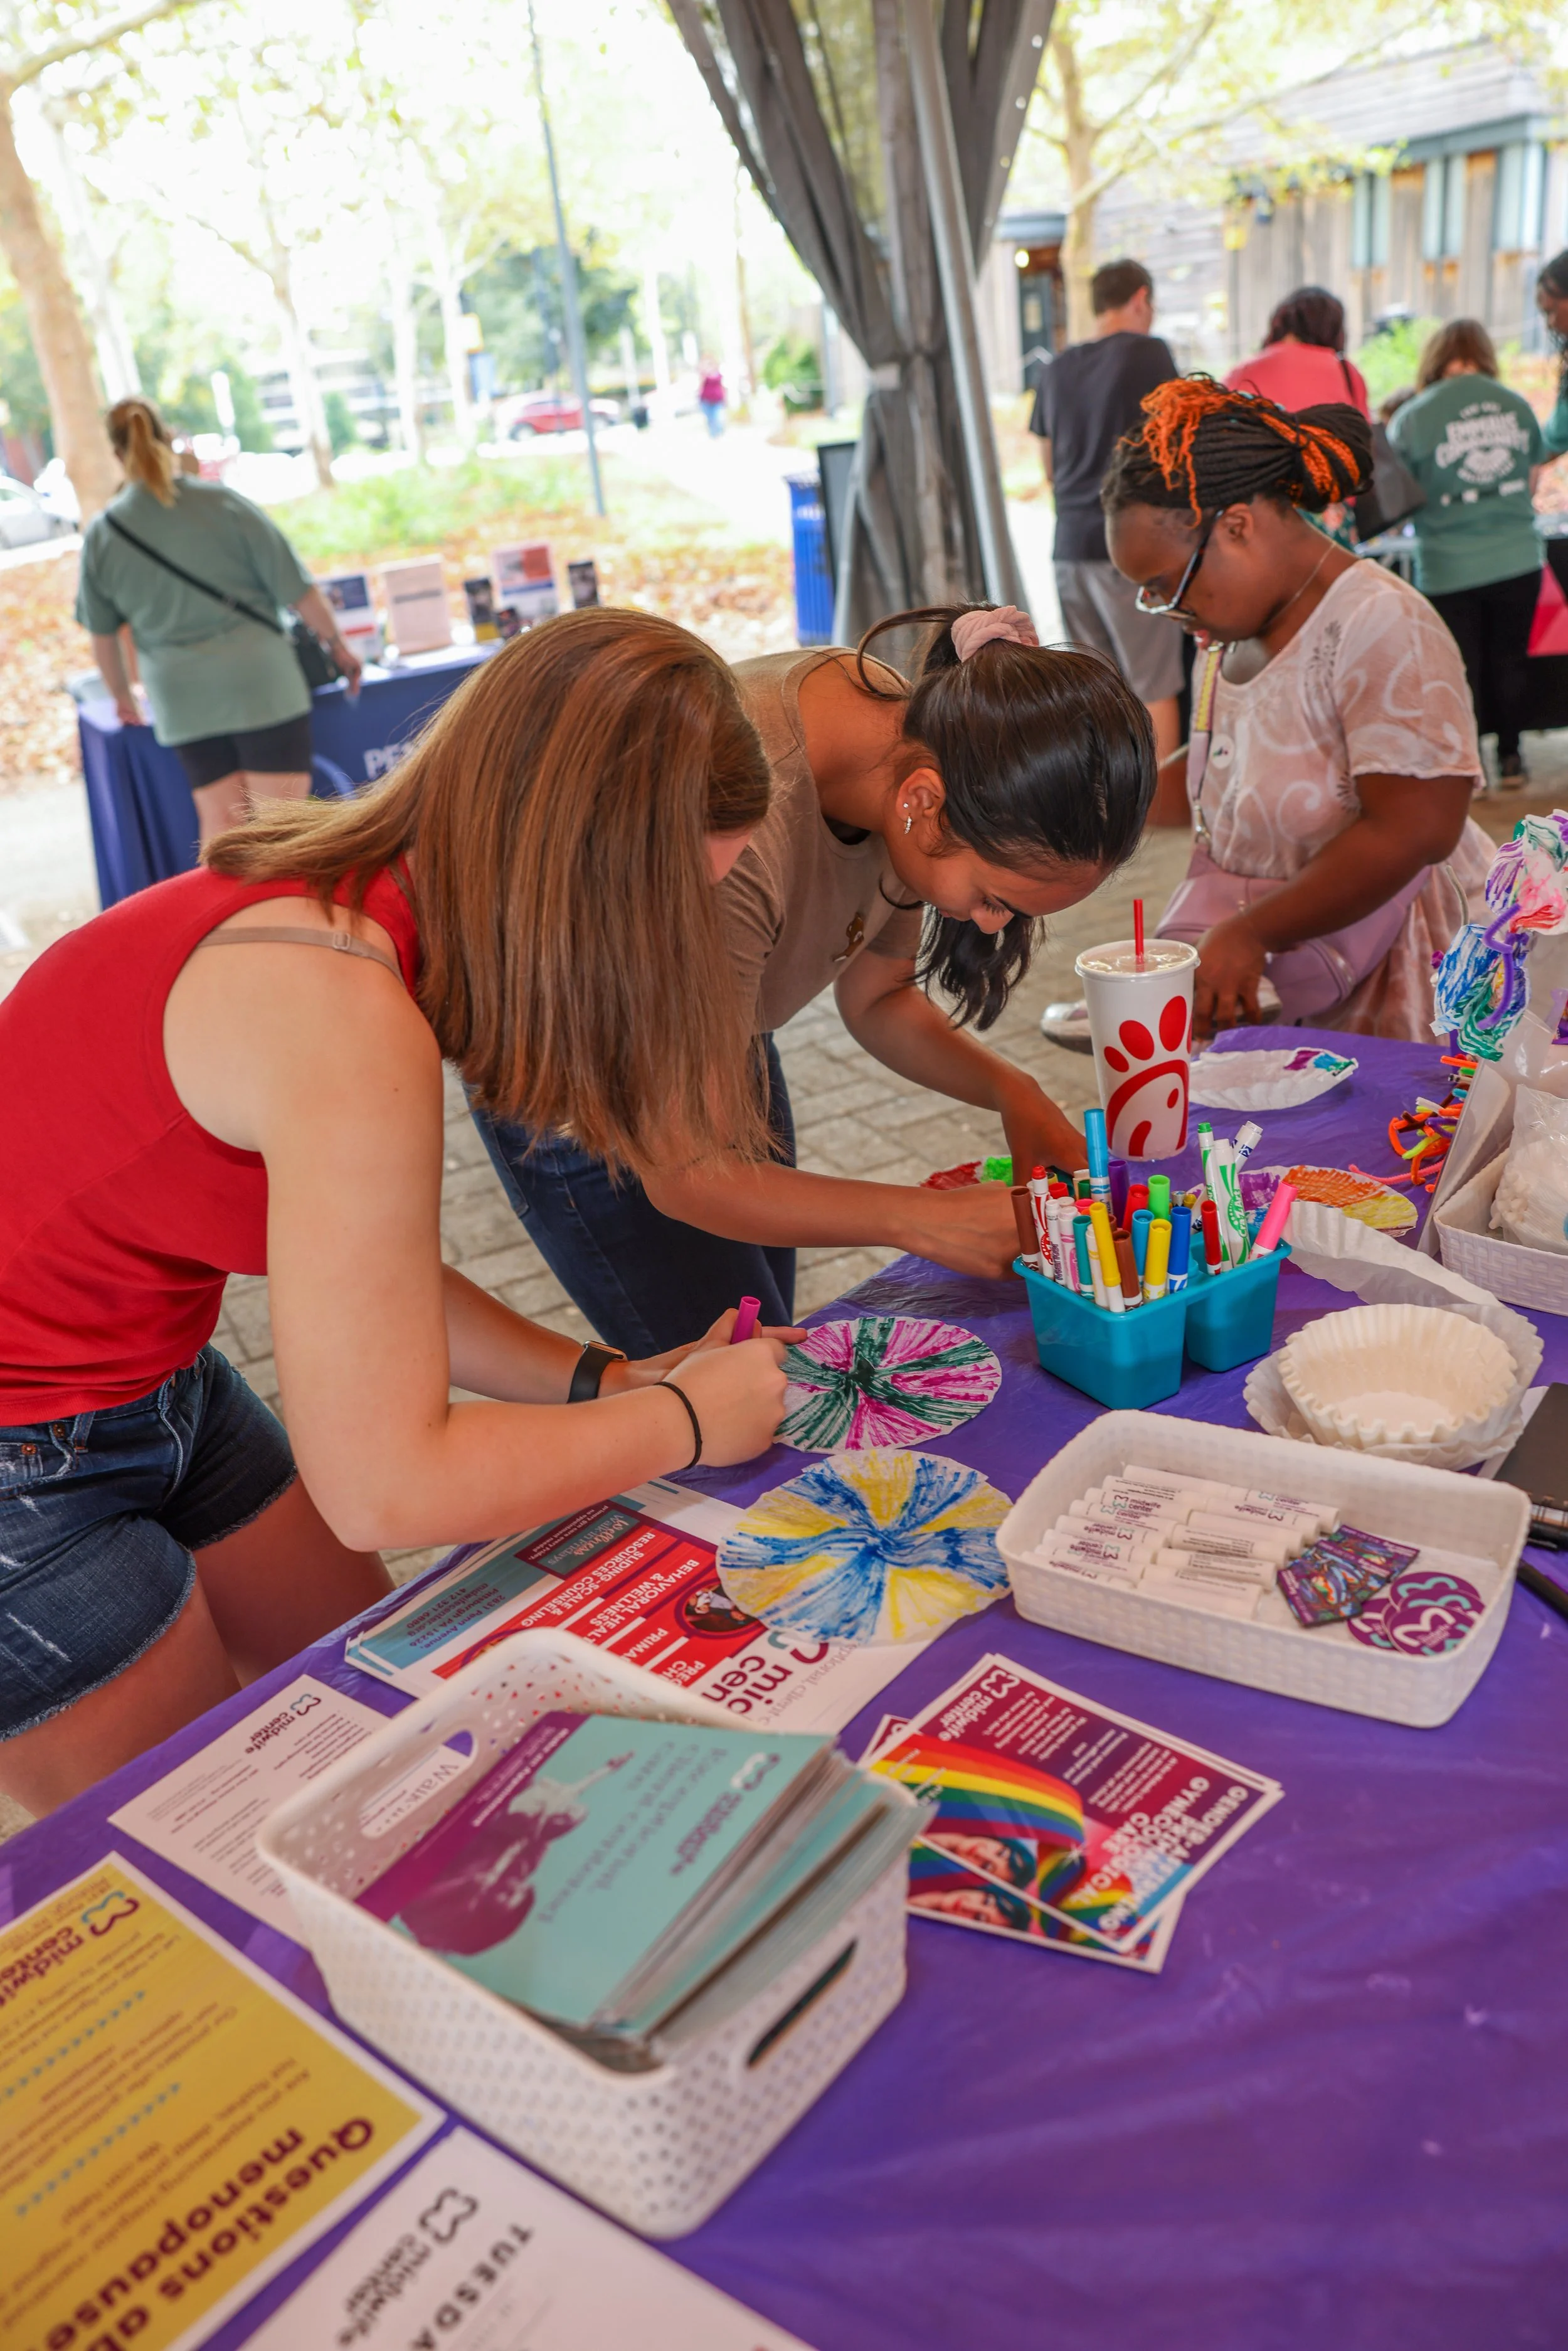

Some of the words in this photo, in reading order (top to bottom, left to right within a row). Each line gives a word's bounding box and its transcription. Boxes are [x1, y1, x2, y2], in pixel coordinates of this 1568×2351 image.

[552, 1512, 588, 1539] appointment
[586, 1504, 608, 1522] primary
[546, 1537, 586, 1568] Fridays
[572, 1516, 628, 1560] Wellness
[591, 1529, 655, 1579] RESOURCES
[520, 1573, 594, 1629] COUNSELING
[560, 1547, 645, 1611] SLIDING-SCALE
[620, 1556, 699, 1618] BEHAVIORAL
[649, 1571, 664, 1585] &
[406, 1581, 489, 1638] midwifecenter.org
[438, 1616, 453, 1630] PA
[450, 1586, 499, 1621] Pittsburgh
[457, 1608, 483, 1628] Penn
[550, 1606, 563, 1618] &
[588, 1579, 652, 1628] WELLNESS
[582, 1612, 623, 1646] HEALT
[620, 1625, 669, 1664] PRIMA
[248, 1710, 289, 1744] center
[936, 1693, 996, 1748] midwife
[938, 1687, 983, 1728] center
[244, 1714, 297, 1757] midwife
[1067, 1771, 1212, 1913] GYNECOLOGICAL
[1099, 1807, 1152, 1858] CARE
[0, 1923, 76, 1987] cente
[0, 1933, 87, 2009] midwi
[153, 2107, 380, 2313] Questions
[40, 2123, 307, 2351] menopause
[406, 2216, 537, 2351] TUESDA
